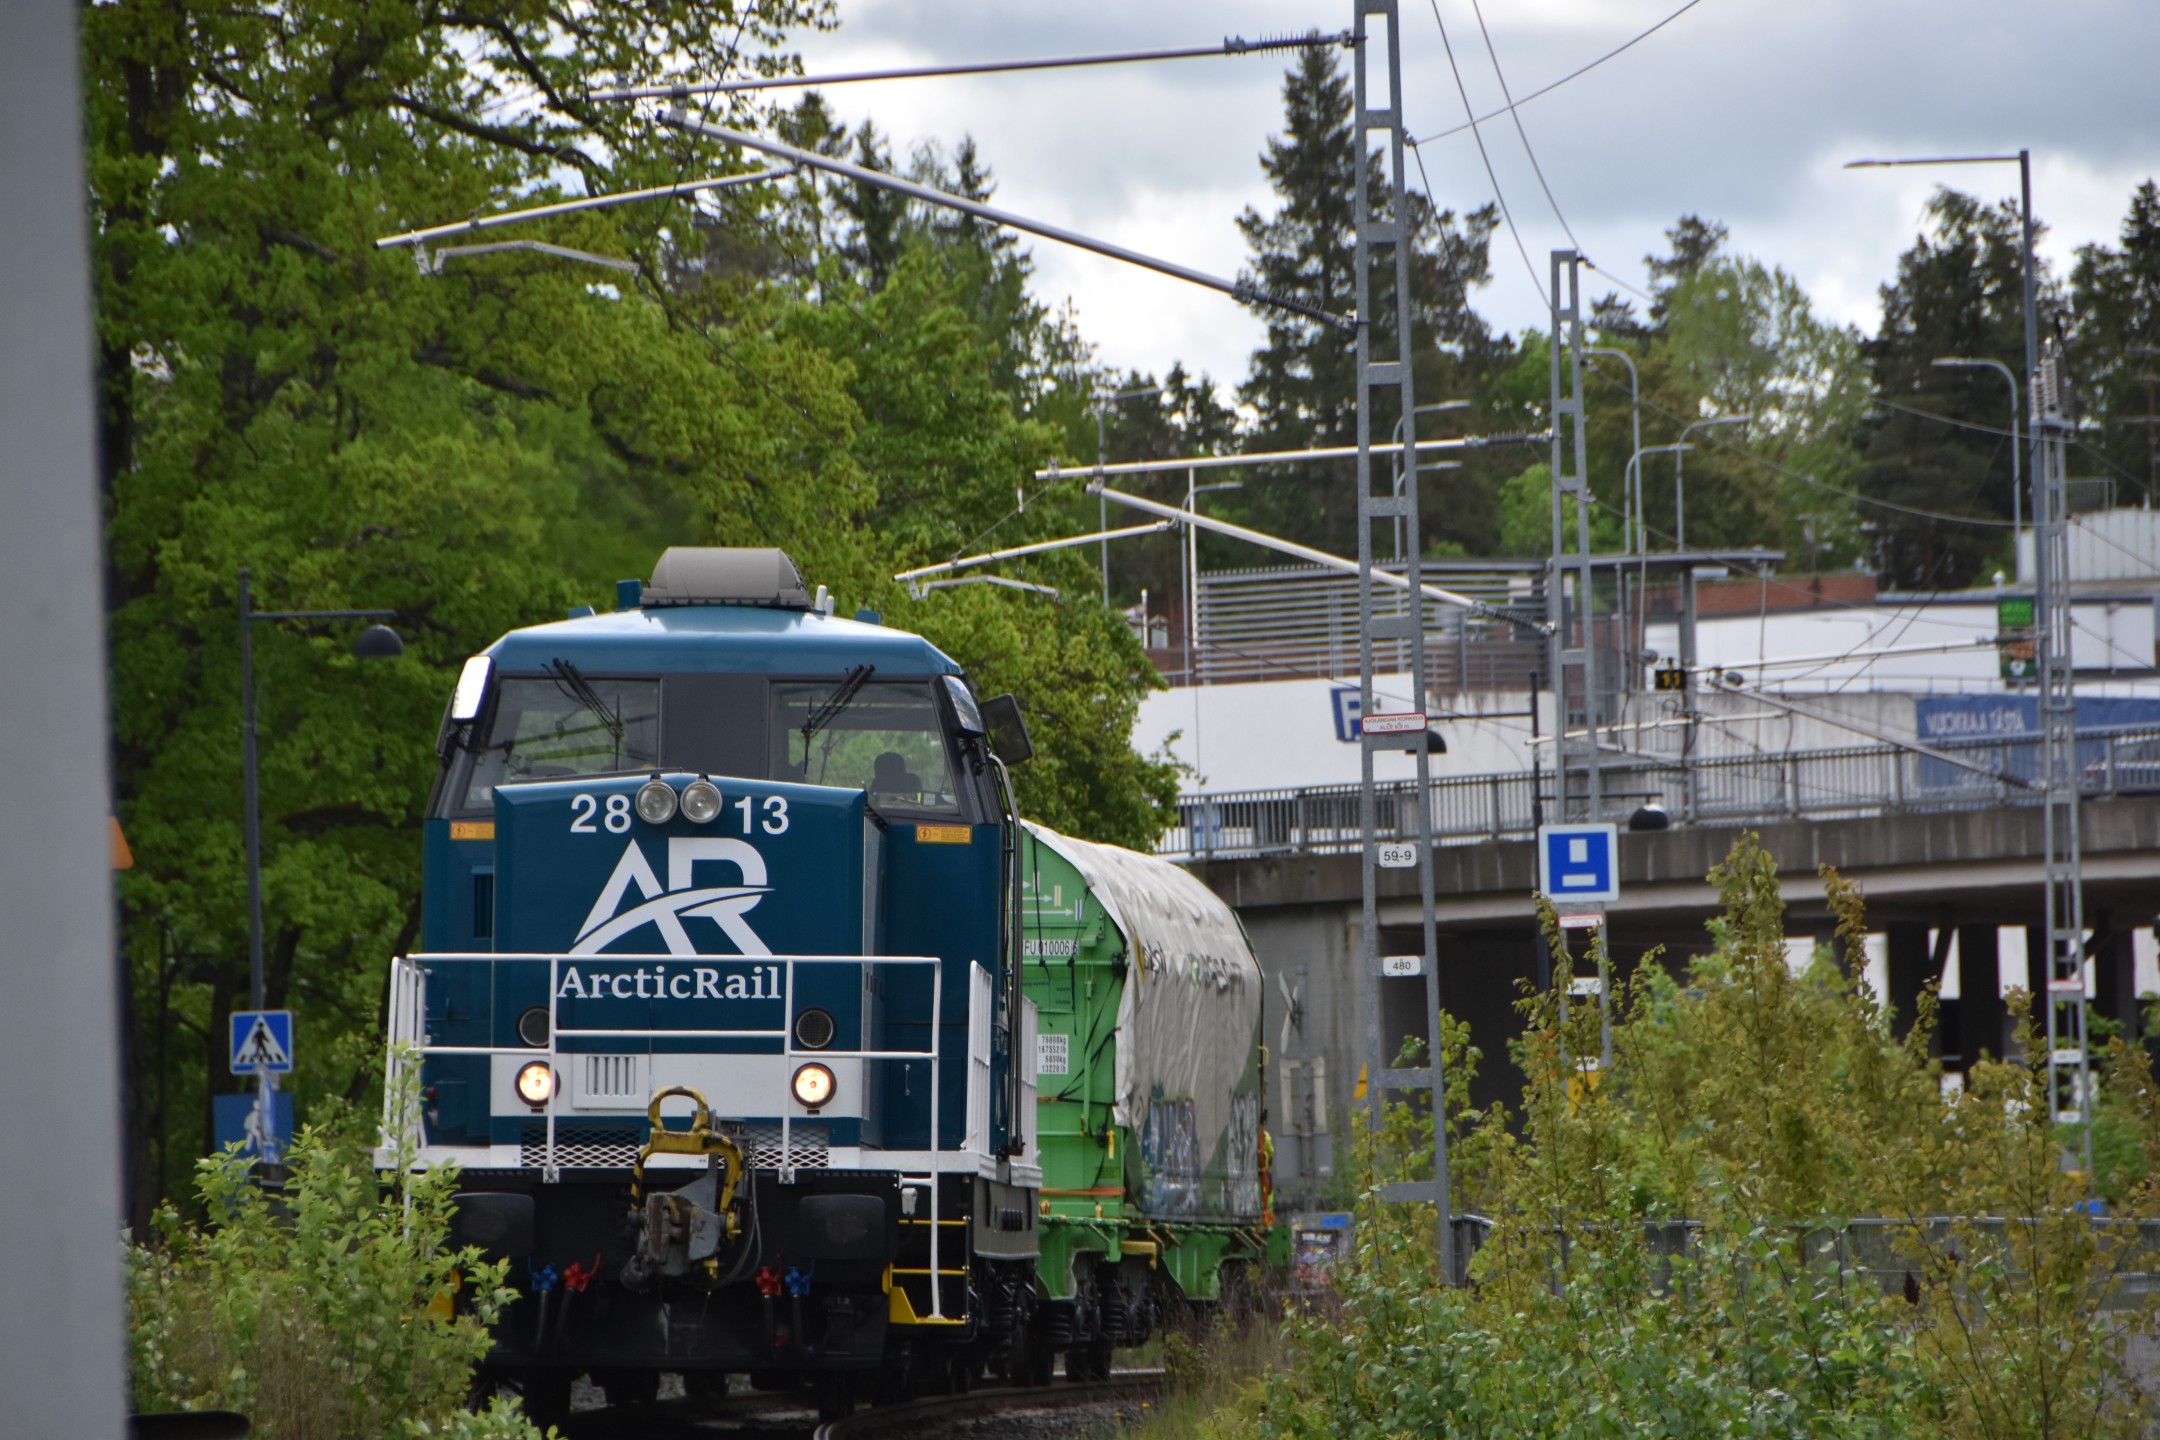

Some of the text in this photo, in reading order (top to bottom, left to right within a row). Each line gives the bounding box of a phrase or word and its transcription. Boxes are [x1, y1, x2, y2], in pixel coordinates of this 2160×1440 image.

[570, 793, 789, 835] 28 13
[1383, 850, 1412, 861] 59-9
[567, 836, 777, 956] AR
[556, 965, 782, 999] ArcticRail
[1392, 961, 1411, 971] 480
